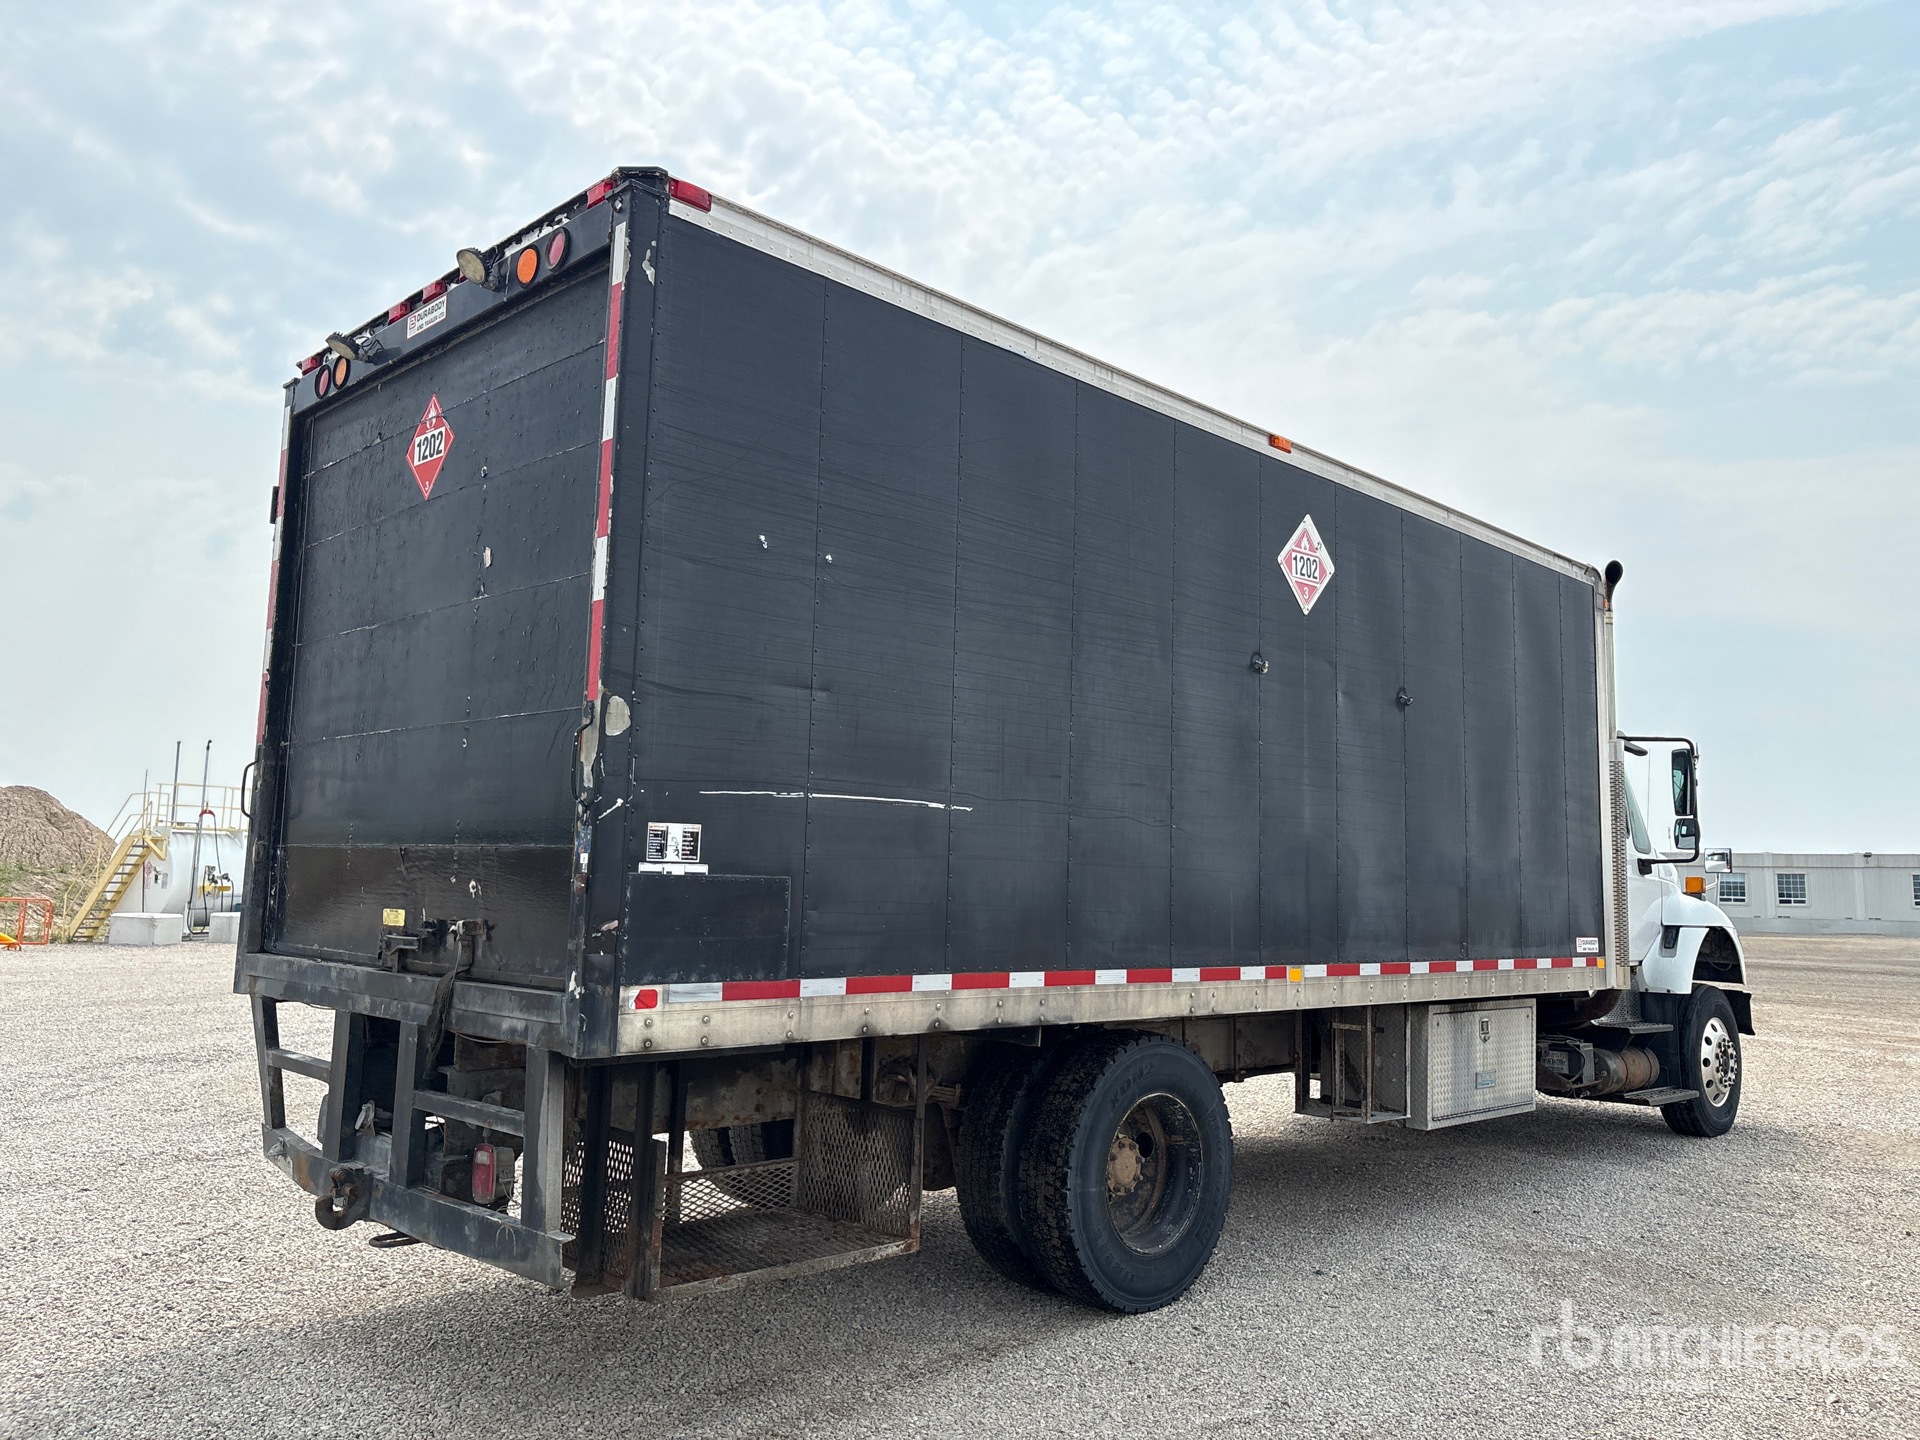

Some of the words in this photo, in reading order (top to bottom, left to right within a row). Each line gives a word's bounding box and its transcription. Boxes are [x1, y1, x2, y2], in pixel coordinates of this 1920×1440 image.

[417, 298, 446, 322] DURABODY
[416, 430, 444, 463] 1202
[425, 480, 430, 491] 3
[1293, 554, 1318, 580] 1202
[1303, 586, 1309, 599] 3
